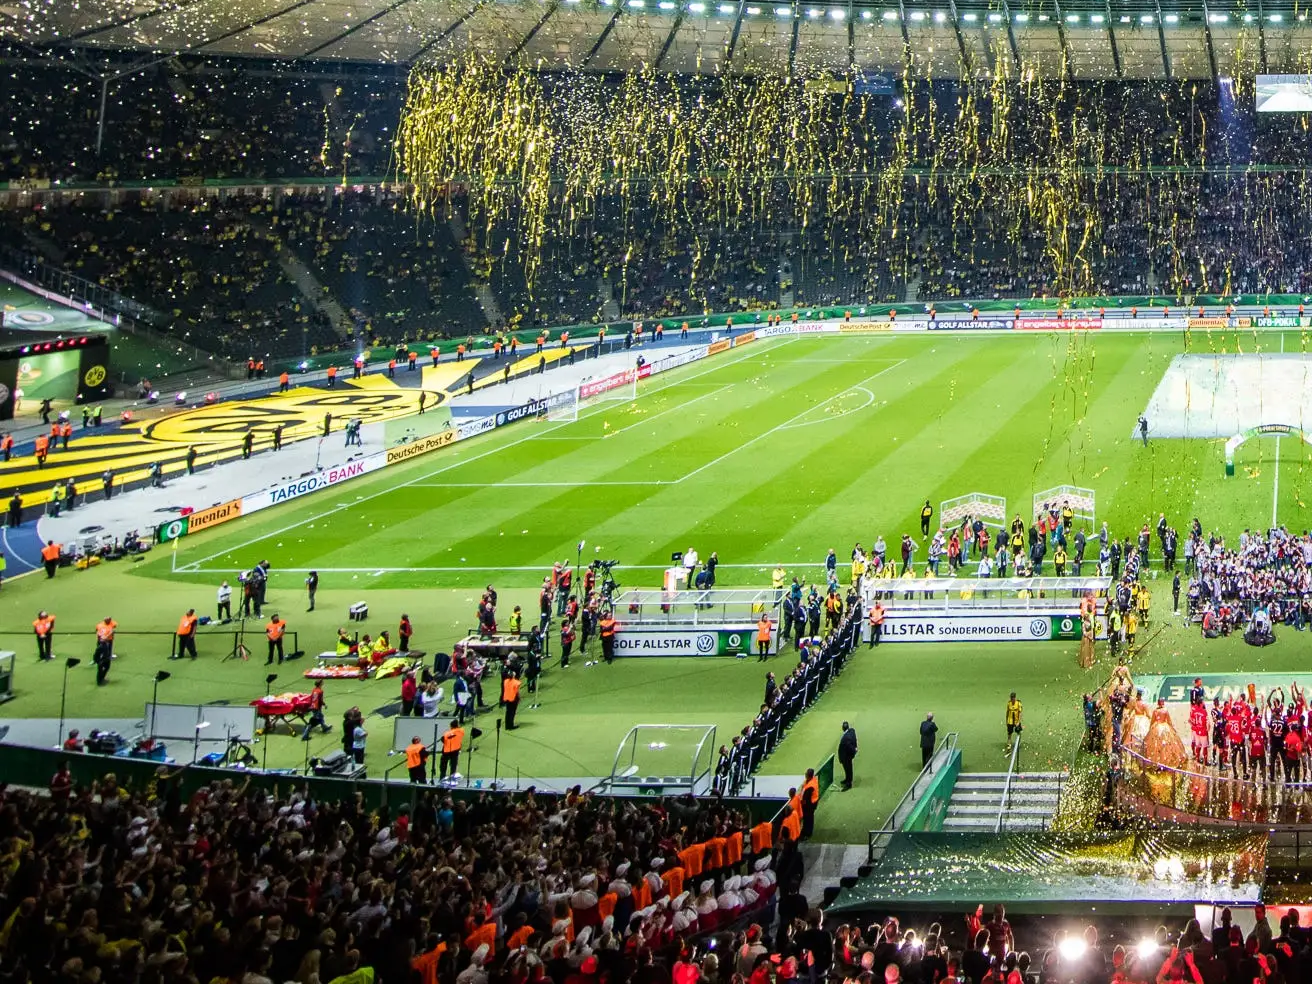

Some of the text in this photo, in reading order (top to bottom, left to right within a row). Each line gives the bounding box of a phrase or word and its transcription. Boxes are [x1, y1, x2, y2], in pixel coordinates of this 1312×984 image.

[938, 321, 989, 329] GOLF ALLSTAR
[507, 406, 529, 422] GOLF
[387, 436, 443, 463] Deutsche Post
[881, 623, 1022, 635] LLSTAR SONDERMODELLE
[613, 639, 691, 649] GOLF ALLSTAR
[1272, 723, 1284, 734] 22
